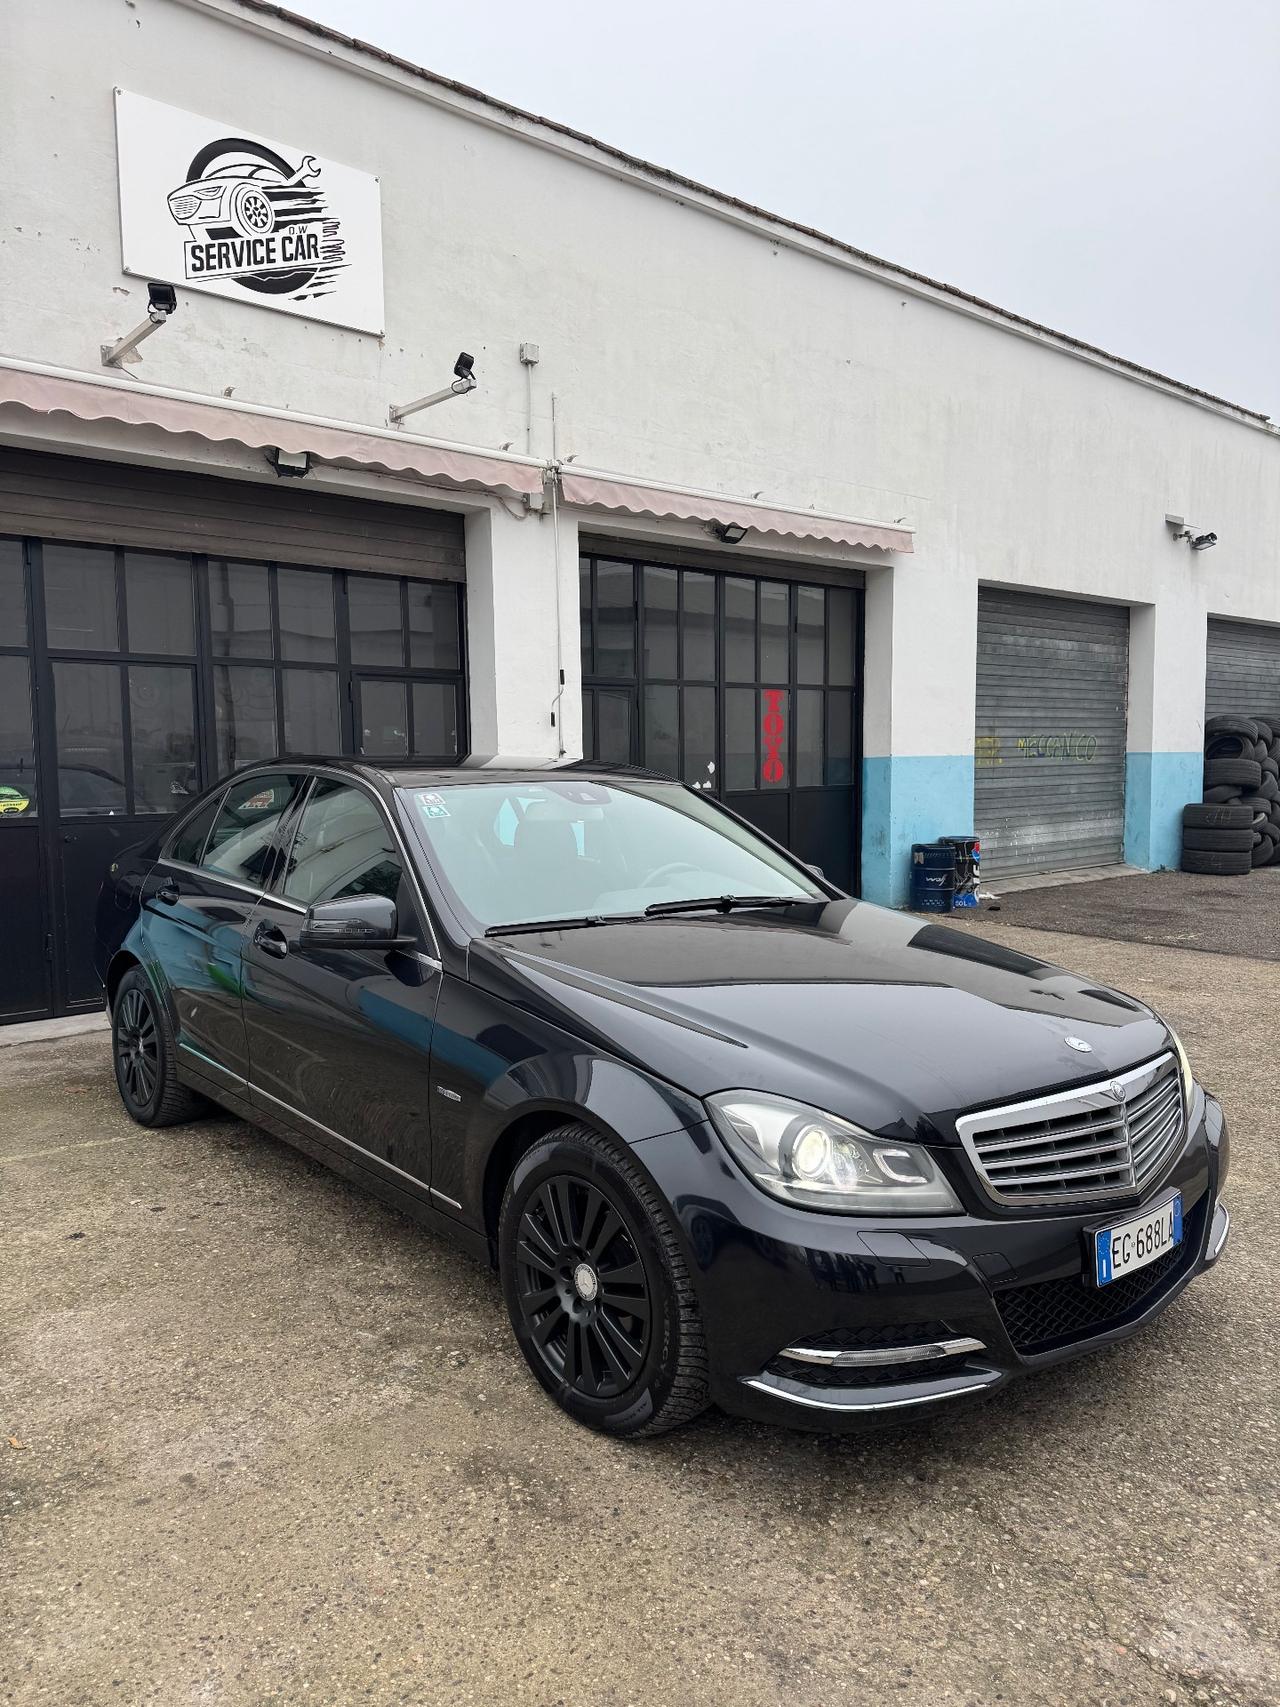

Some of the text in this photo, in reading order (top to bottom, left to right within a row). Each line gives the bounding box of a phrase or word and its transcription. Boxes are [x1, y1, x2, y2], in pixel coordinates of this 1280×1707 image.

[191, 234, 319, 272] SERVICE CAR
[1112, 1211, 1173, 1269] EG 688LA
